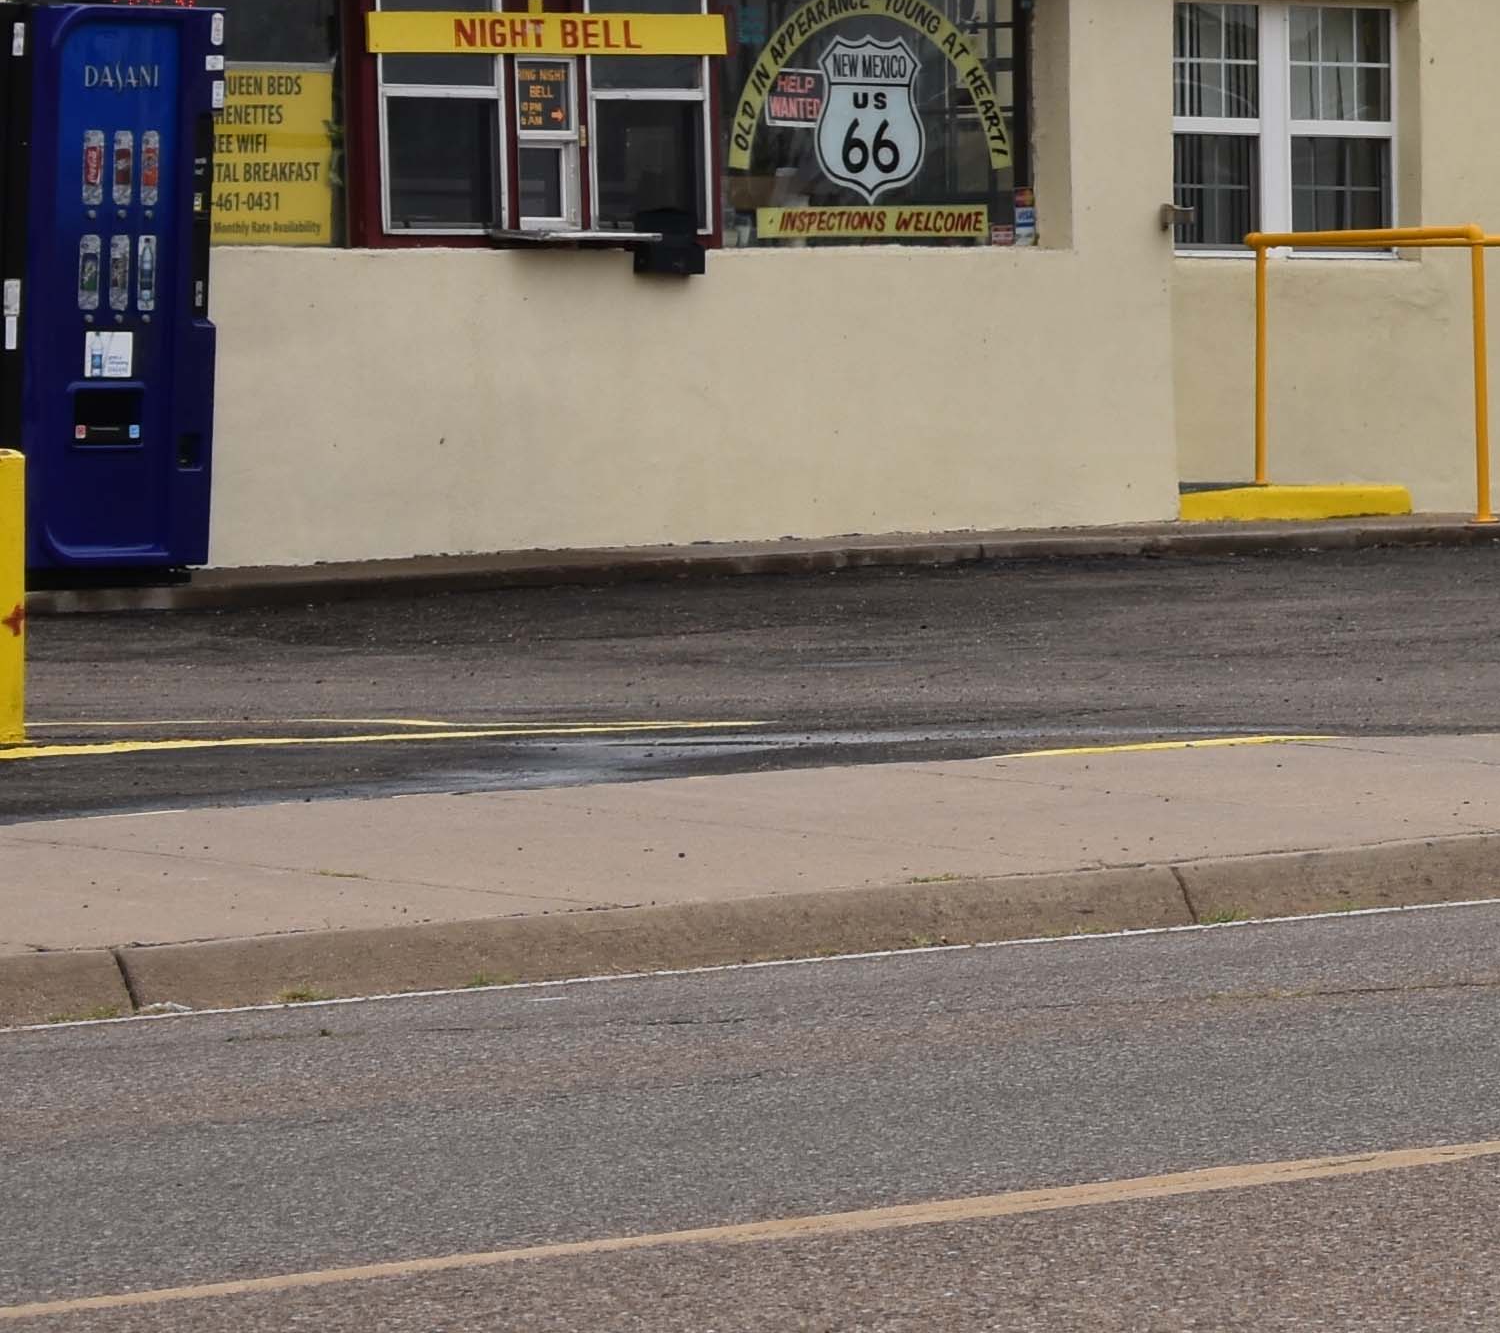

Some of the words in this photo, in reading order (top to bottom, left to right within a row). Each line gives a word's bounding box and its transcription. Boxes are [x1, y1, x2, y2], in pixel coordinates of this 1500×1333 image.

[453, 18, 545, 48] NIGHT
[560, 18, 643, 49] BELL
[832, 52, 858, 78] NEW
[861, 53, 907, 80] MEXICO
[84, 64, 160, 92] DASANI
[223, 75, 263, 97] UEEN
[267, 75, 302, 96] BEDS
[777, 75, 815, 93] HELP
[529, 84, 555, 99] BELL
[734, 100, 756, 151] OLD
[751, 65, 772, 96] IN
[941, 32, 970, 61] AT
[852, 91, 888, 111] US
[768, 95, 821, 119] WANTED
[236, 133, 267, 154] WIFI
[841, 117, 901, 175] 66
[243, 161, 321, 183] BREAKFAST
[211, 192, 280, 212] -461-0431
[779, 210, 887, 232] INSPECTIONS
[894, 209, 985, 232] WELCOME
